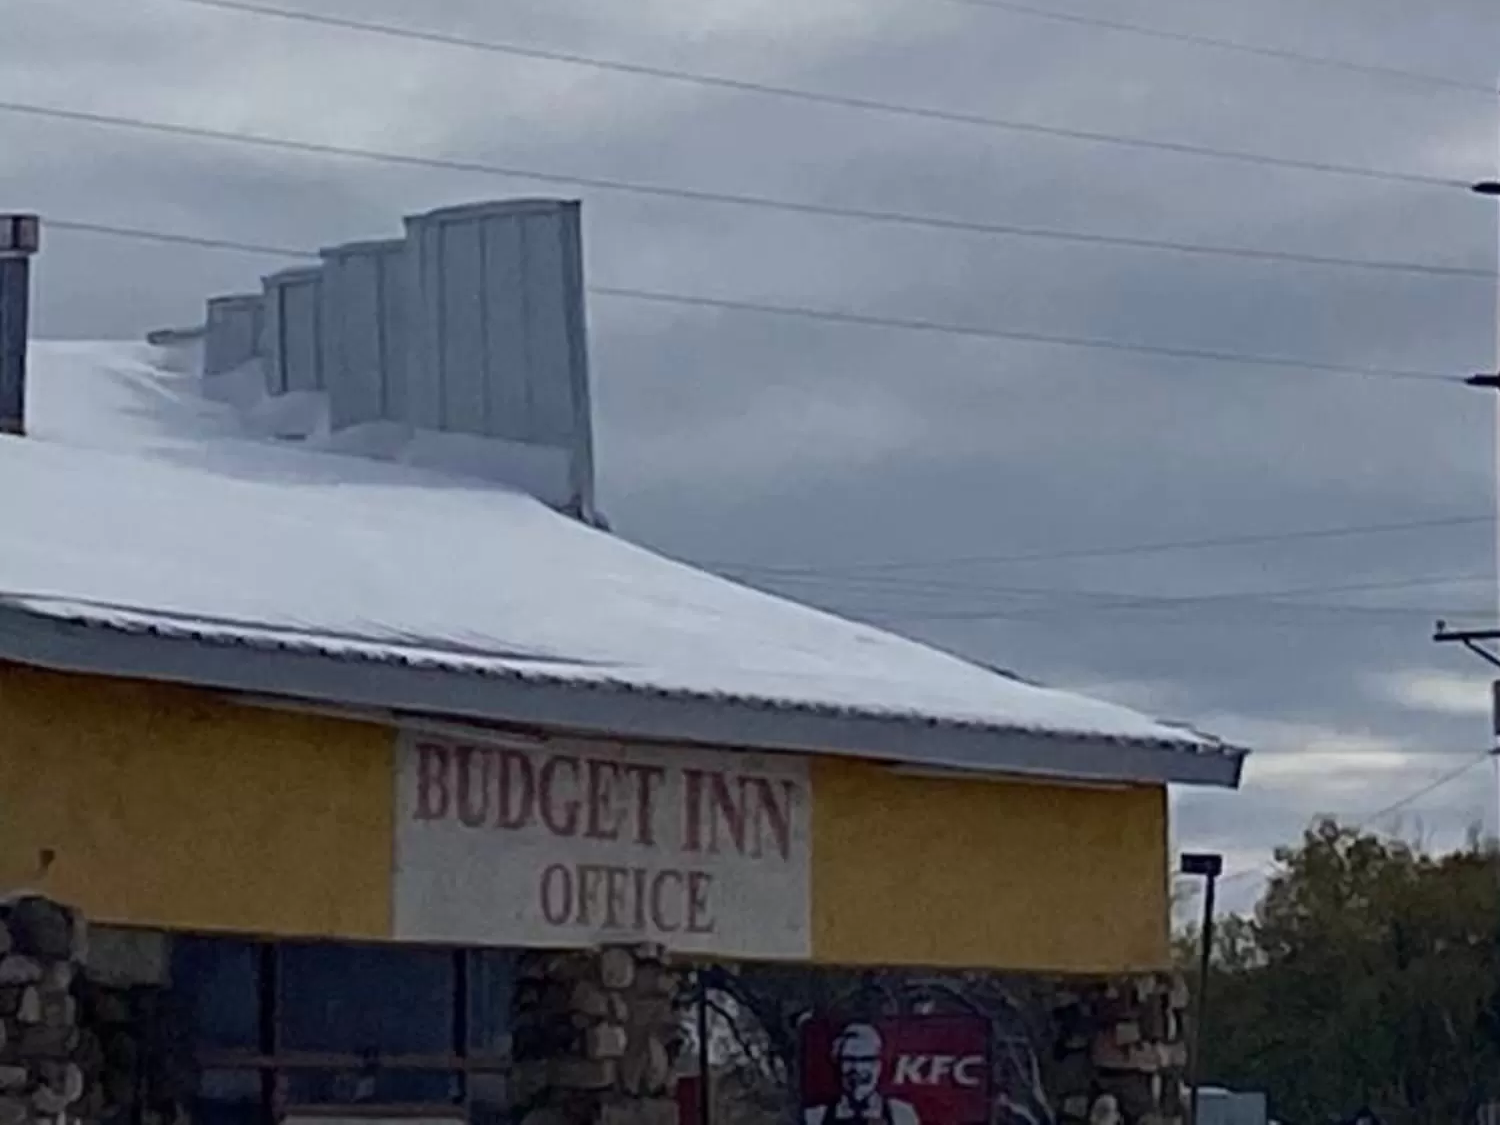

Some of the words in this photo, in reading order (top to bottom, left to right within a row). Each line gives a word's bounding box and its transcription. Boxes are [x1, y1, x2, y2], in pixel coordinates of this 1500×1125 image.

[413, 742, 666, 846] BUDGET
[680, 767, 795, 862] INN
[539, 863, 716, 934] OFFICE
[892, 1055, 985, 1086] KFC
